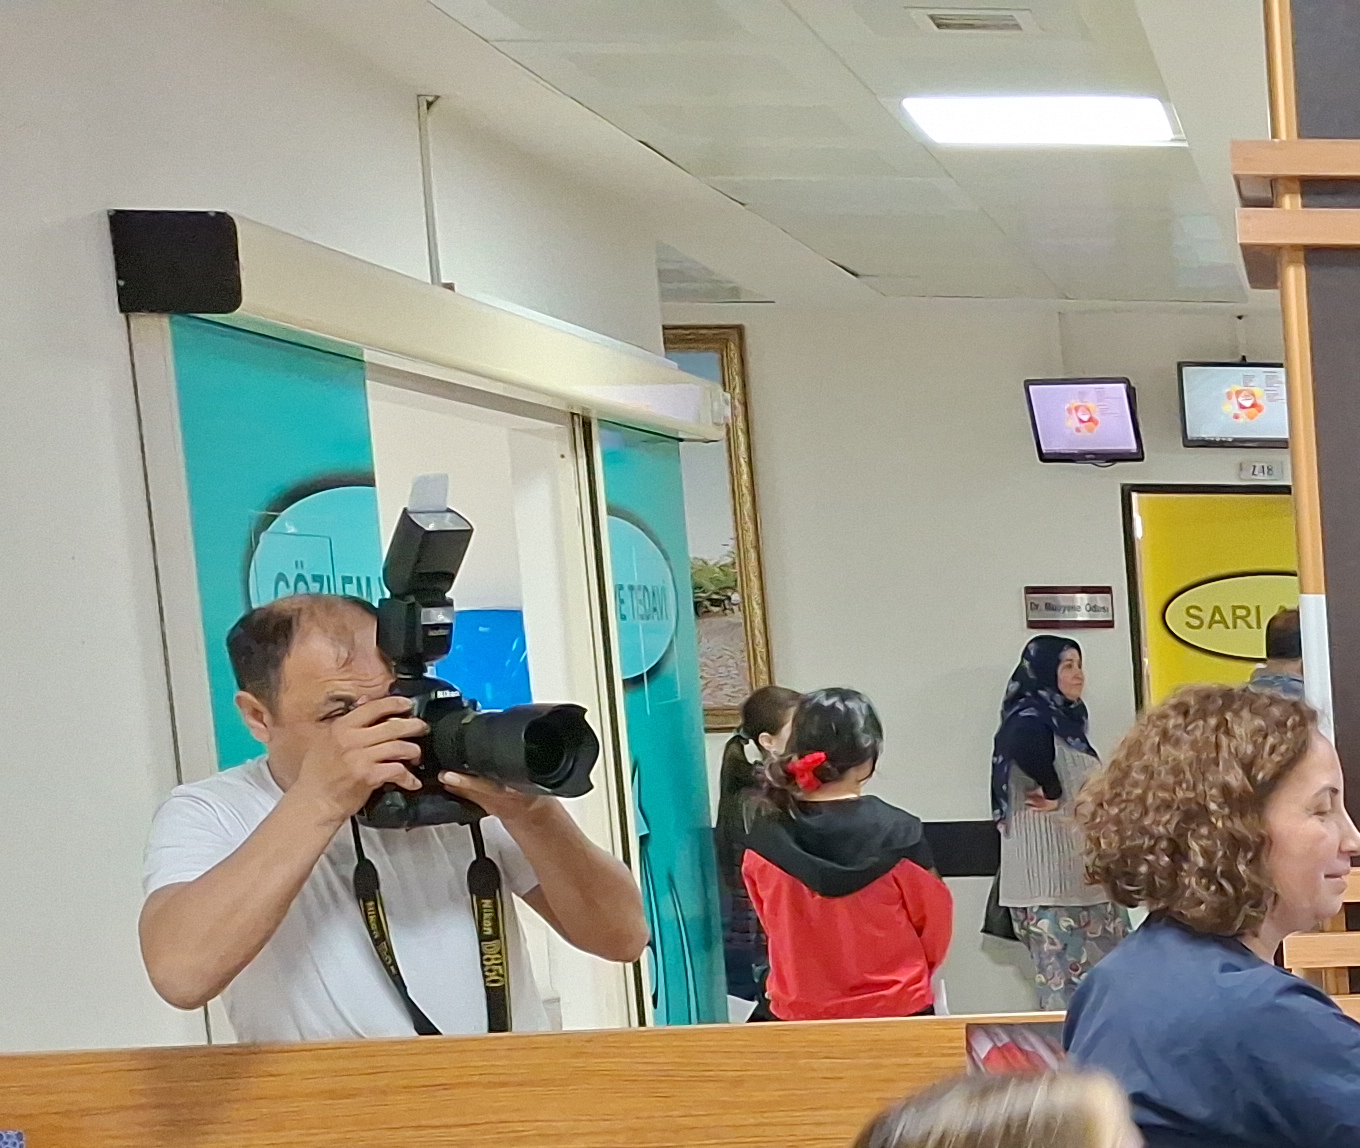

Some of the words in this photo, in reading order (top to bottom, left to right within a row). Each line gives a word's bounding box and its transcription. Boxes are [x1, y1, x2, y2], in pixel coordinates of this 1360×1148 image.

[1184, 605, 1263, 631] SARI
[480, 898, 496, 936] Nikon
[480, 939, 505, 987] D850
